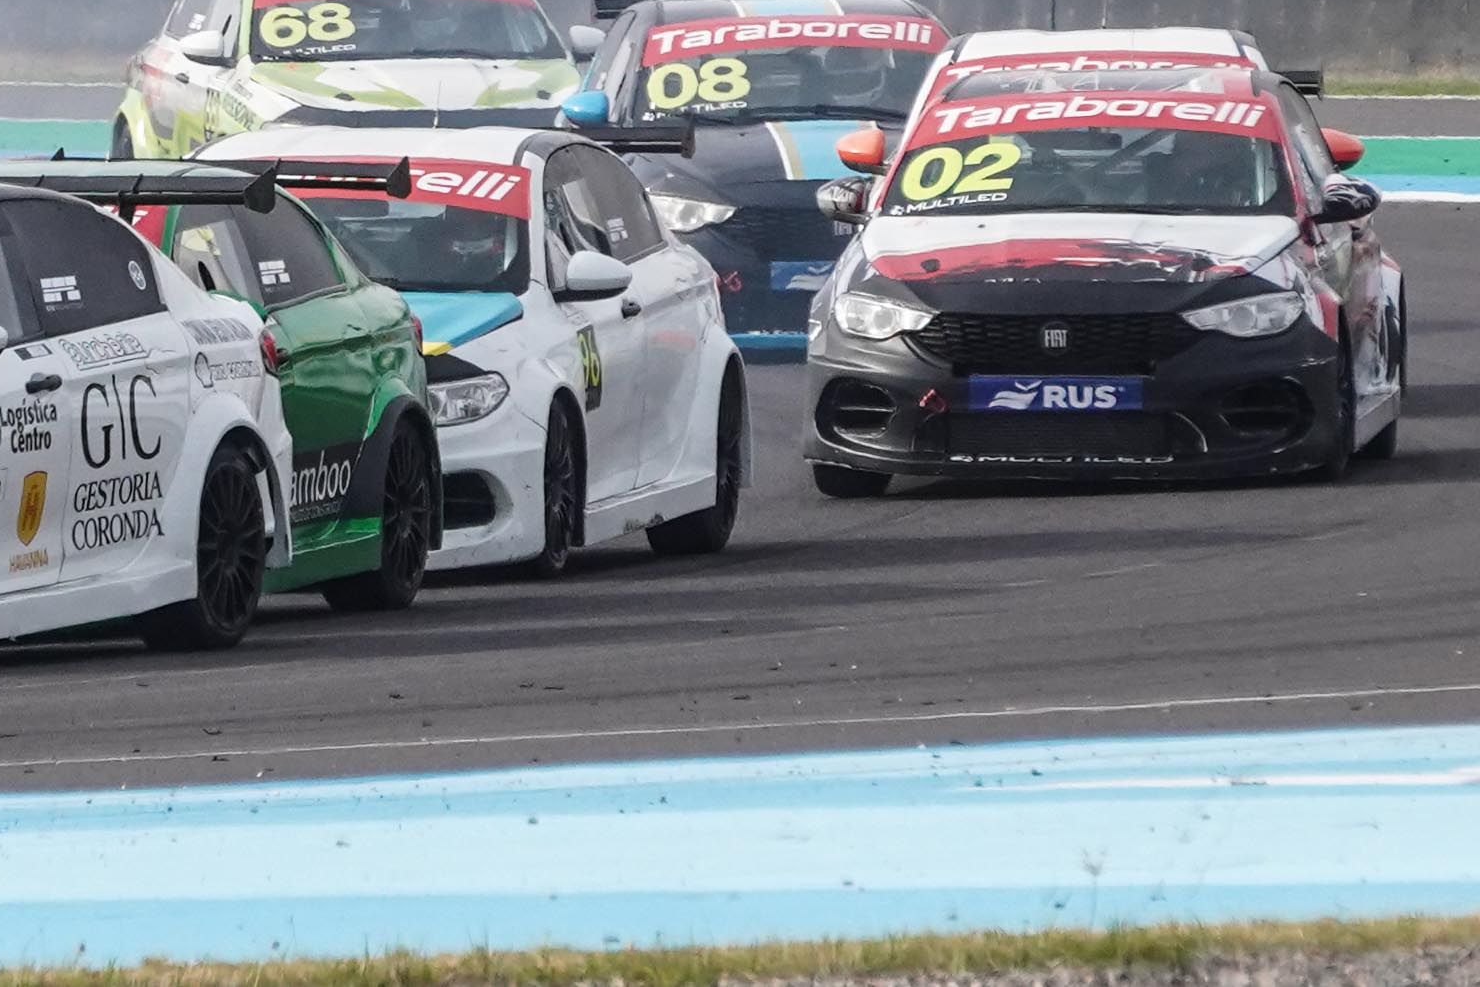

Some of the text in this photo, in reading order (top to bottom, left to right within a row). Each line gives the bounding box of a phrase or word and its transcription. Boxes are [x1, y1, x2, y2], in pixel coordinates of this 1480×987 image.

[259, 2, 357, 48] 68
[651, 19, 933, 55] Taraborelli
[646, 58, 752, 110] 08
[935, 96, 1266, 135] Taraborelli
[902, 143, 1022, 201] 02
[906, 192, 1008, 214] MULTILED
[1044, 329, 1069, 348] FIAT
[1042, 385, 1118, 409] RUS
[10, 426, 52, 454] Centro
[73, 469, 163, 513] GESTORIA
[72, 508, 165, 551] CORONDA
